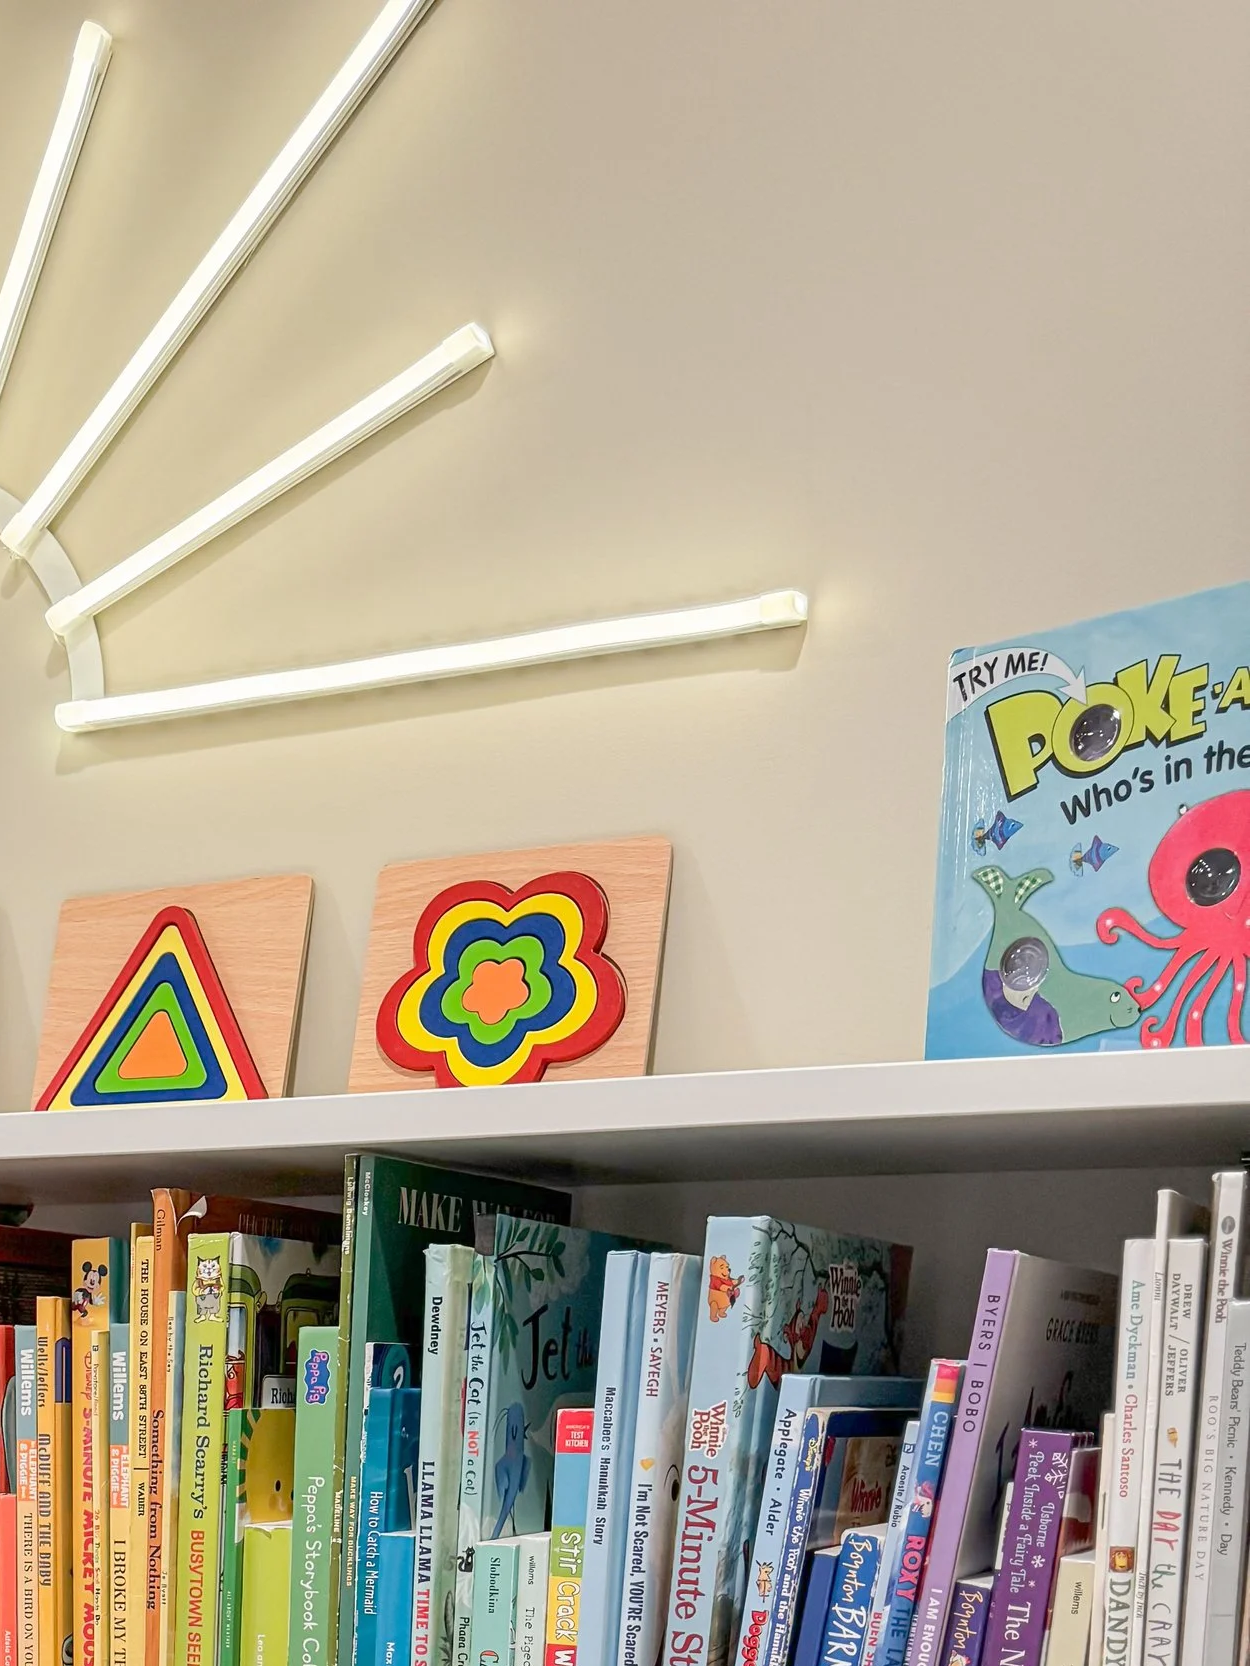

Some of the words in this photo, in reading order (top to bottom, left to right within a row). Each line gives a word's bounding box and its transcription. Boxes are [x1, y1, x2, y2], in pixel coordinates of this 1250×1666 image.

[953, 656, 1000, 702] TRY
[1005, 651, 1049, 674] ME!
[1060, 766, 1155, 824] Who's
[1165, 755, 1192, 785] in
[1203, 740, 1250, 774] the
[155, 1209, 165, 1251] Gilman
[653, 1281, 669, 1334] MEYERS
[978, 1295, 1001, 1351] BYERS
[1169, 1273, 1181, 1330] DAYWALT
[1182, 1284, 1192, 1319] DREW
[428, 1297, 442, 1355] Dewdney
[21, 1348, 34, 1416] Willems
[112, 1351, 126, 1421] Willems
[197, 1344, 213, 1428] Richard
[646, 1347, 662, 1397] SAYEGH
[1165, 1344, 1176, 1396] JEFFERS
[1177, 1348, 1188, 1393] OLIVER
[963, 1380, 984, 1432] BOBO
[150, 1409, 164, 1494] Something
[775, 1409, 797, 1479] Applegate
[191, 1436, 209, 1519] Scarry's
[420, 1461, 435, 1520] LLAMA
[150, 1502, 161, 1539] from
[301, 1476, 325, 1533] Peppa's
[369, 1492, 383, 1514] How
[369, 1517, 381, 1527] to
[765, 1498, 782, 1536] Alder
[795, 1489, 811, 1522] Winnie
[24, 1513, 33, 1556] THERE
[367, 1531, 380, 1558] Catch
[417, 1526, 433, 1584] LLAMA
[559, 1532, 582, 1574] Stir
[674, 1465, 720, 1620] 5-Minute
[791, 1526, 802, 1544] the
[24, 1561, 32, 1571] IS
[147, 1545, 160, 1609] Nothing
[188, 1530, 205, 1627] BUSYTOWN
[784, 1549, 799, 1571] Pooh
[842, 1539, 872, 1603] Boynton
[895, 1535, 925, 1602] ROXY
[1138, 1572, 1146, 1590] Inch
[24, 1589, 33, 1619] BIRD
[300, 1540, 322, 1629] Storybook
[364, 1570, 379, 1614] Mermaid
[489, 1558, 500, 1614] Slobodkina
[780, 1574, 796, 1596] and
[1136, 1592, 1144, 1600] by
[416, 1589, 430, 1629] TIME
[525, 1607, 535, 1629] The
[556, 1582, 580, 1642] Crack
[777, 1601, 790, 1619] the
[892, 1608, 910, 1638] THE
[926, 1597, 940, 1620] AM
[1004, 1601, 1031, 1640] The
[1136, 1602, 1144, 1619] Inch
[25, 1624, 33, 1639] ON
[257, 1635, 265, 1651] Leo
[386, 1642, 395, 1664] Max
[415, 1635, 428, 1655] TO
